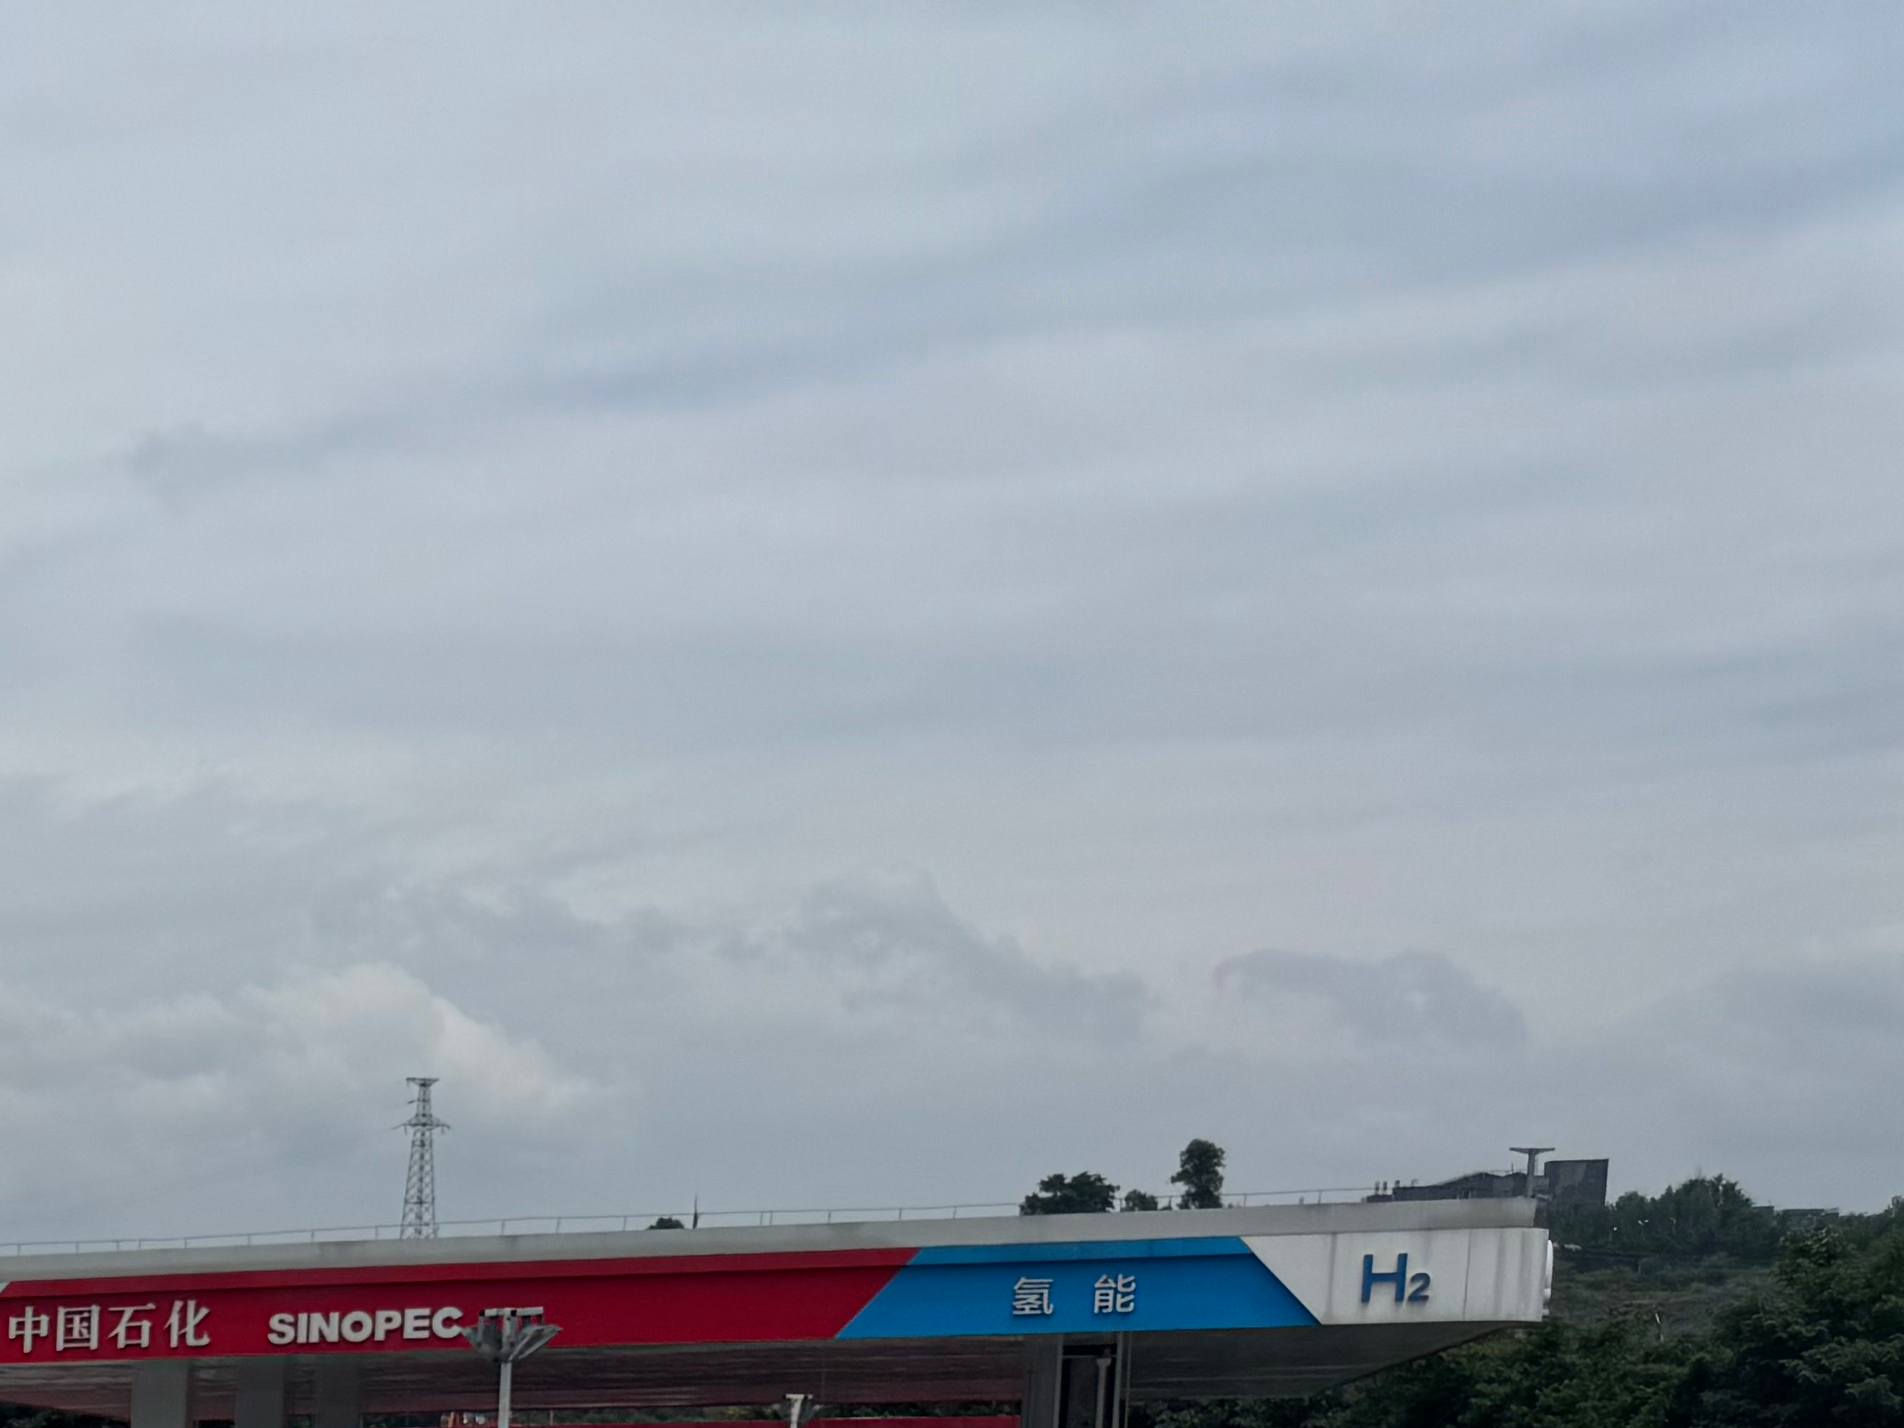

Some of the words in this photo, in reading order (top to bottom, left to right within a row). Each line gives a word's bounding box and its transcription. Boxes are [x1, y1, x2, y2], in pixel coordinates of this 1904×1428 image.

[7, 1299, 212, 1354] 中国石化
[267, 1307, 464, 1345] SINOPEC
